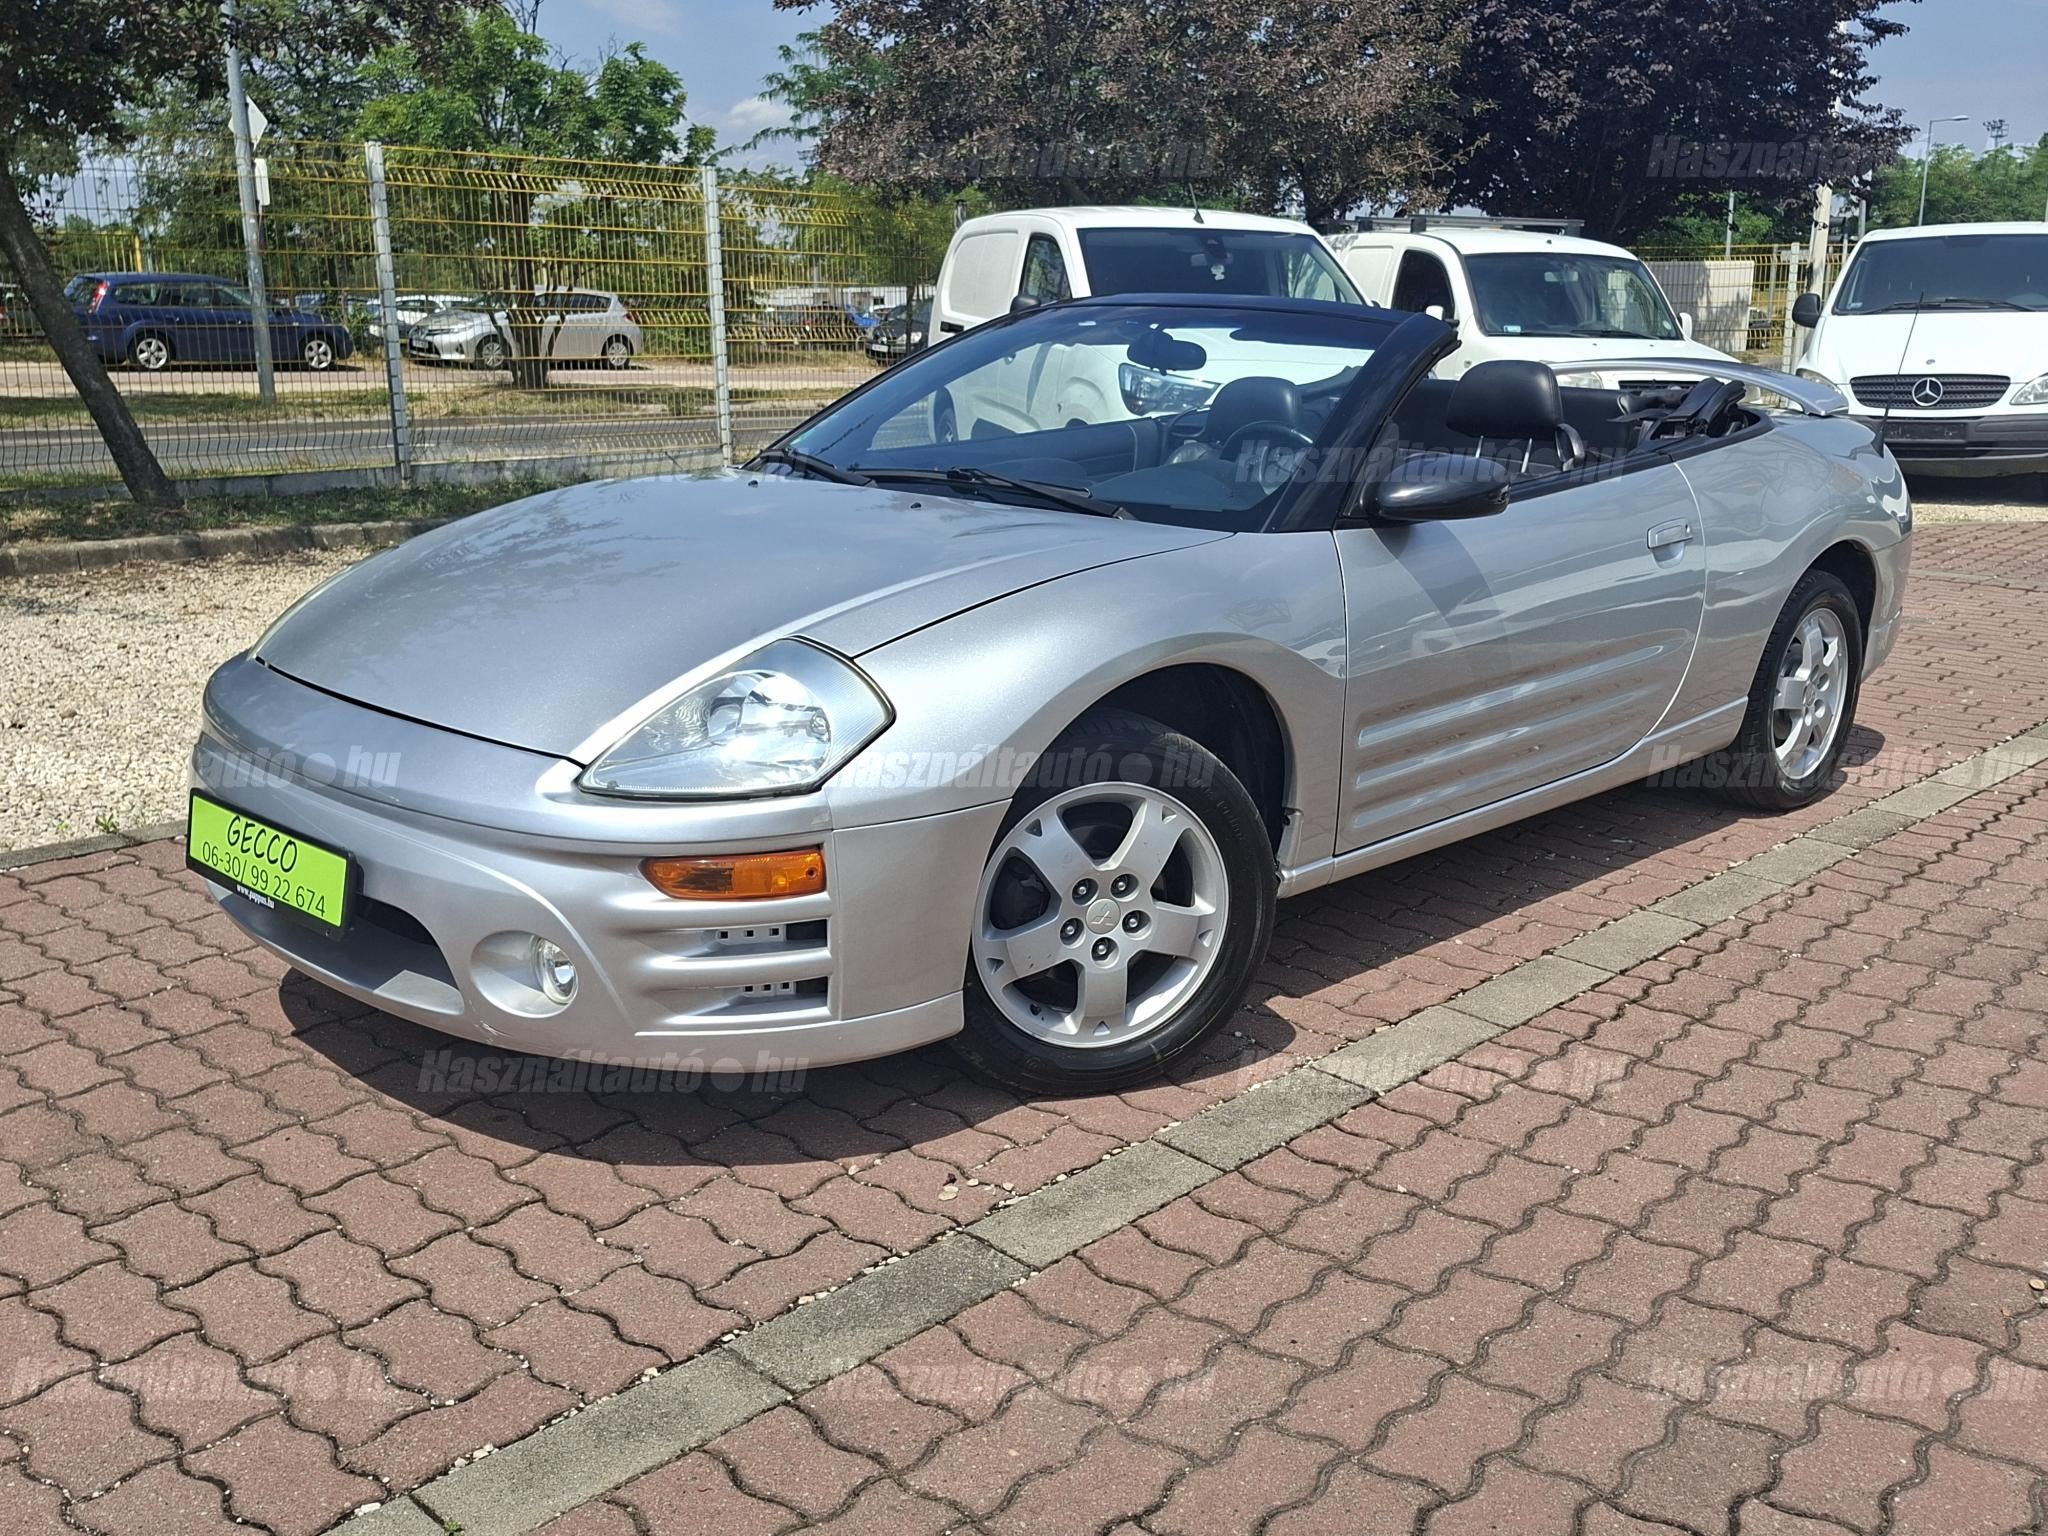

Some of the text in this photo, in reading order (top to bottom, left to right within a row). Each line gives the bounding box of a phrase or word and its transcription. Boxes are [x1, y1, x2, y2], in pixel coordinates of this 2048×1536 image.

[228, 816, 297, 872] GECCO
[251, 865, 269, 891] 99
[273, 875, 291, 902] 22
[296, 886, 326, 917] 674
